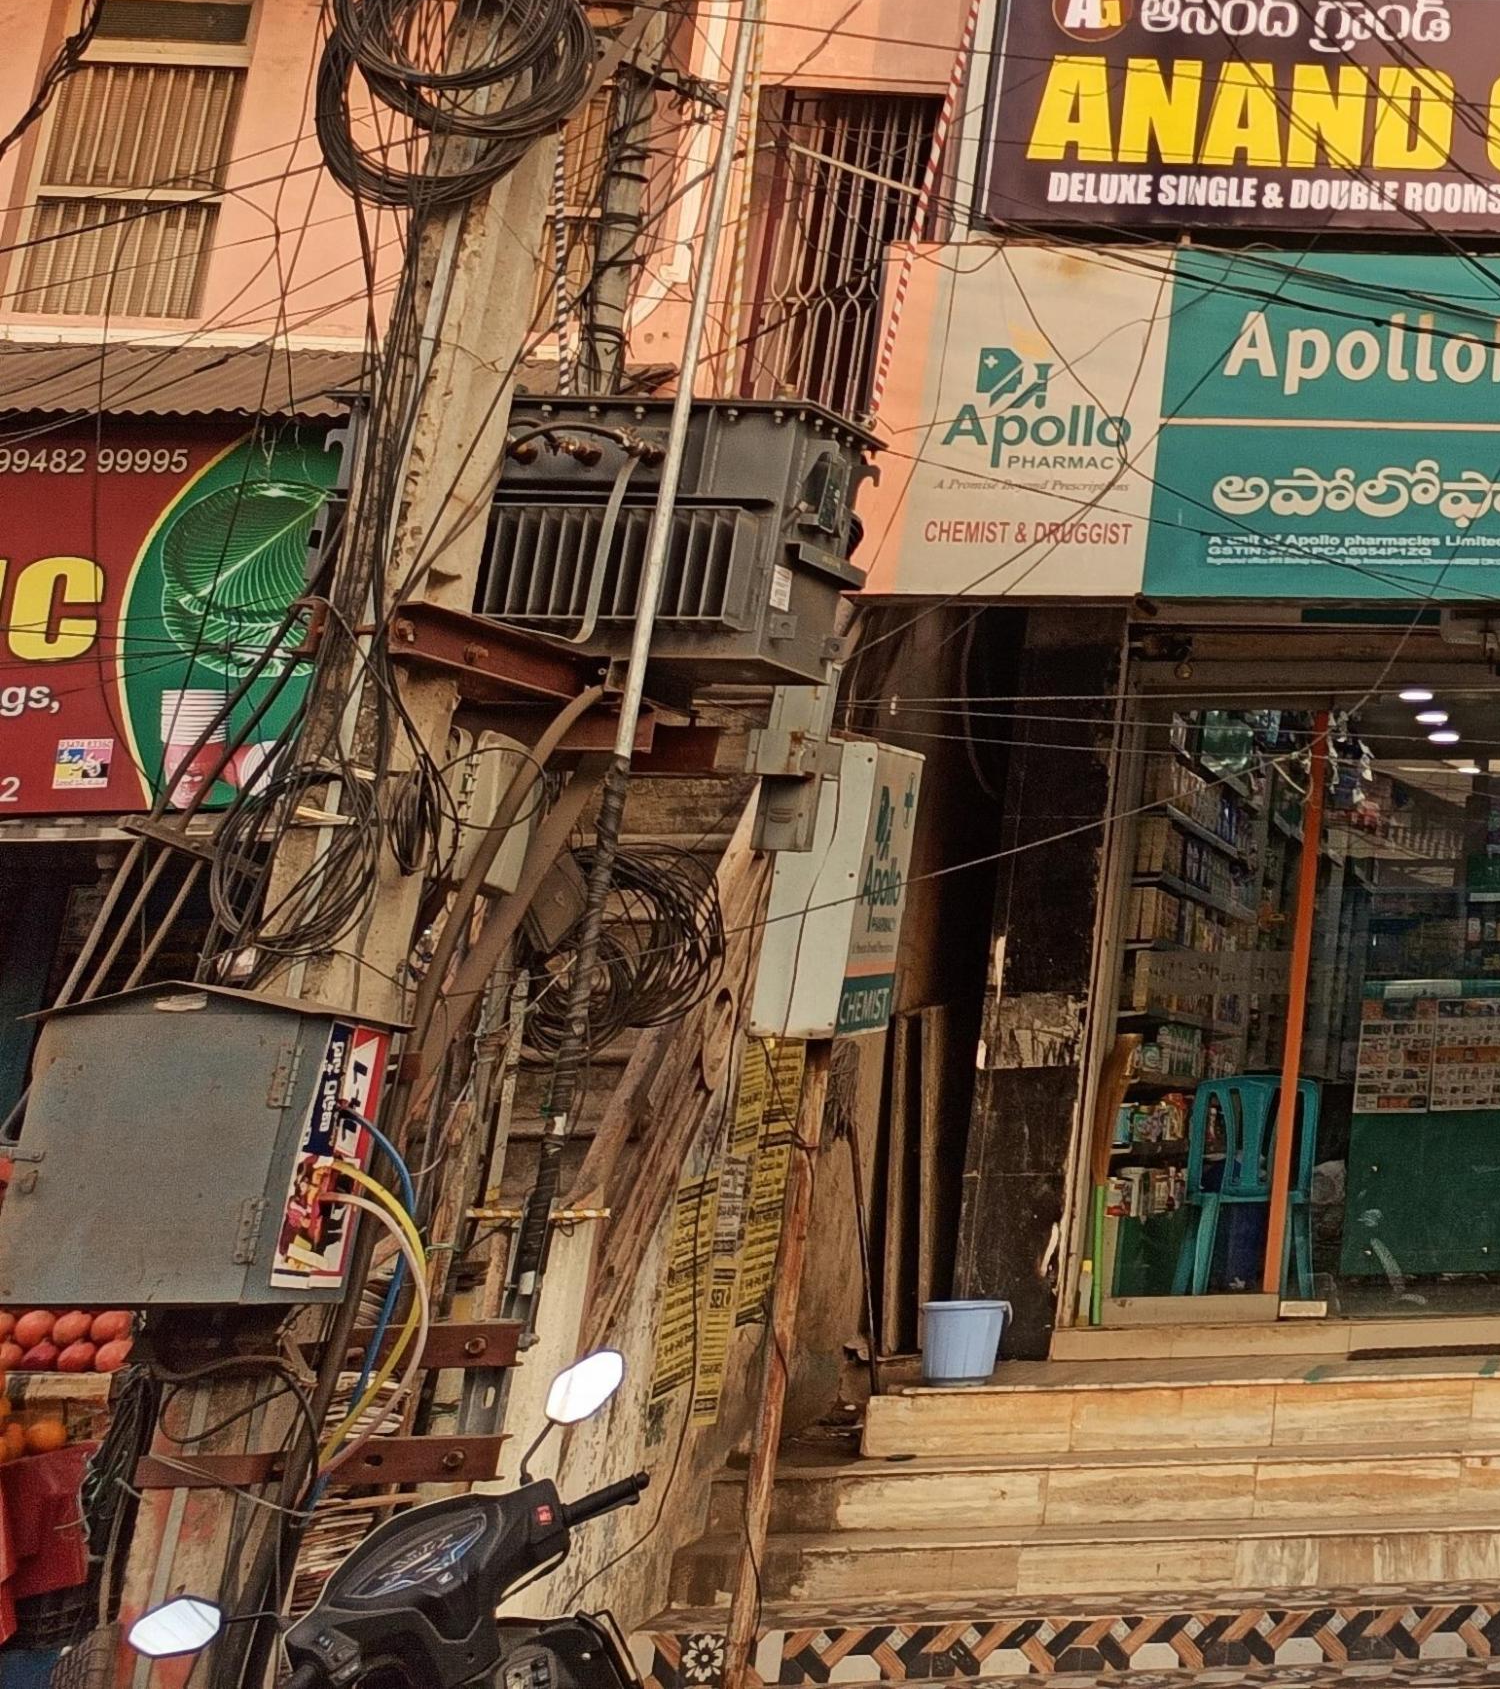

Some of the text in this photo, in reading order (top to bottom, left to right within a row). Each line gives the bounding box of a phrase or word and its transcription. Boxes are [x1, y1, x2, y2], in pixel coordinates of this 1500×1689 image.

[1026, 54, 1457, 171] ANAND
[1047, 171, 1153, 208] DELUXE
[1157, 174, 1258, 210] SINGLE
[1290, 179, 1397, 214] DOUBLE
[941, 404, 1131, 468] Apollo
[97, 448, 189, 474] 99995
[1007, 455, 1128, 471] PHARMACY
[924, 520, 1133, 546] CHEMIST & DRUGGIST
[1286, 535, 1342, 548] Apollo
[1344, 534, 1441, 548] pharmacies
[0, 555, 105, 663] C
[838, 987, 891, 1026] CHEMIST
